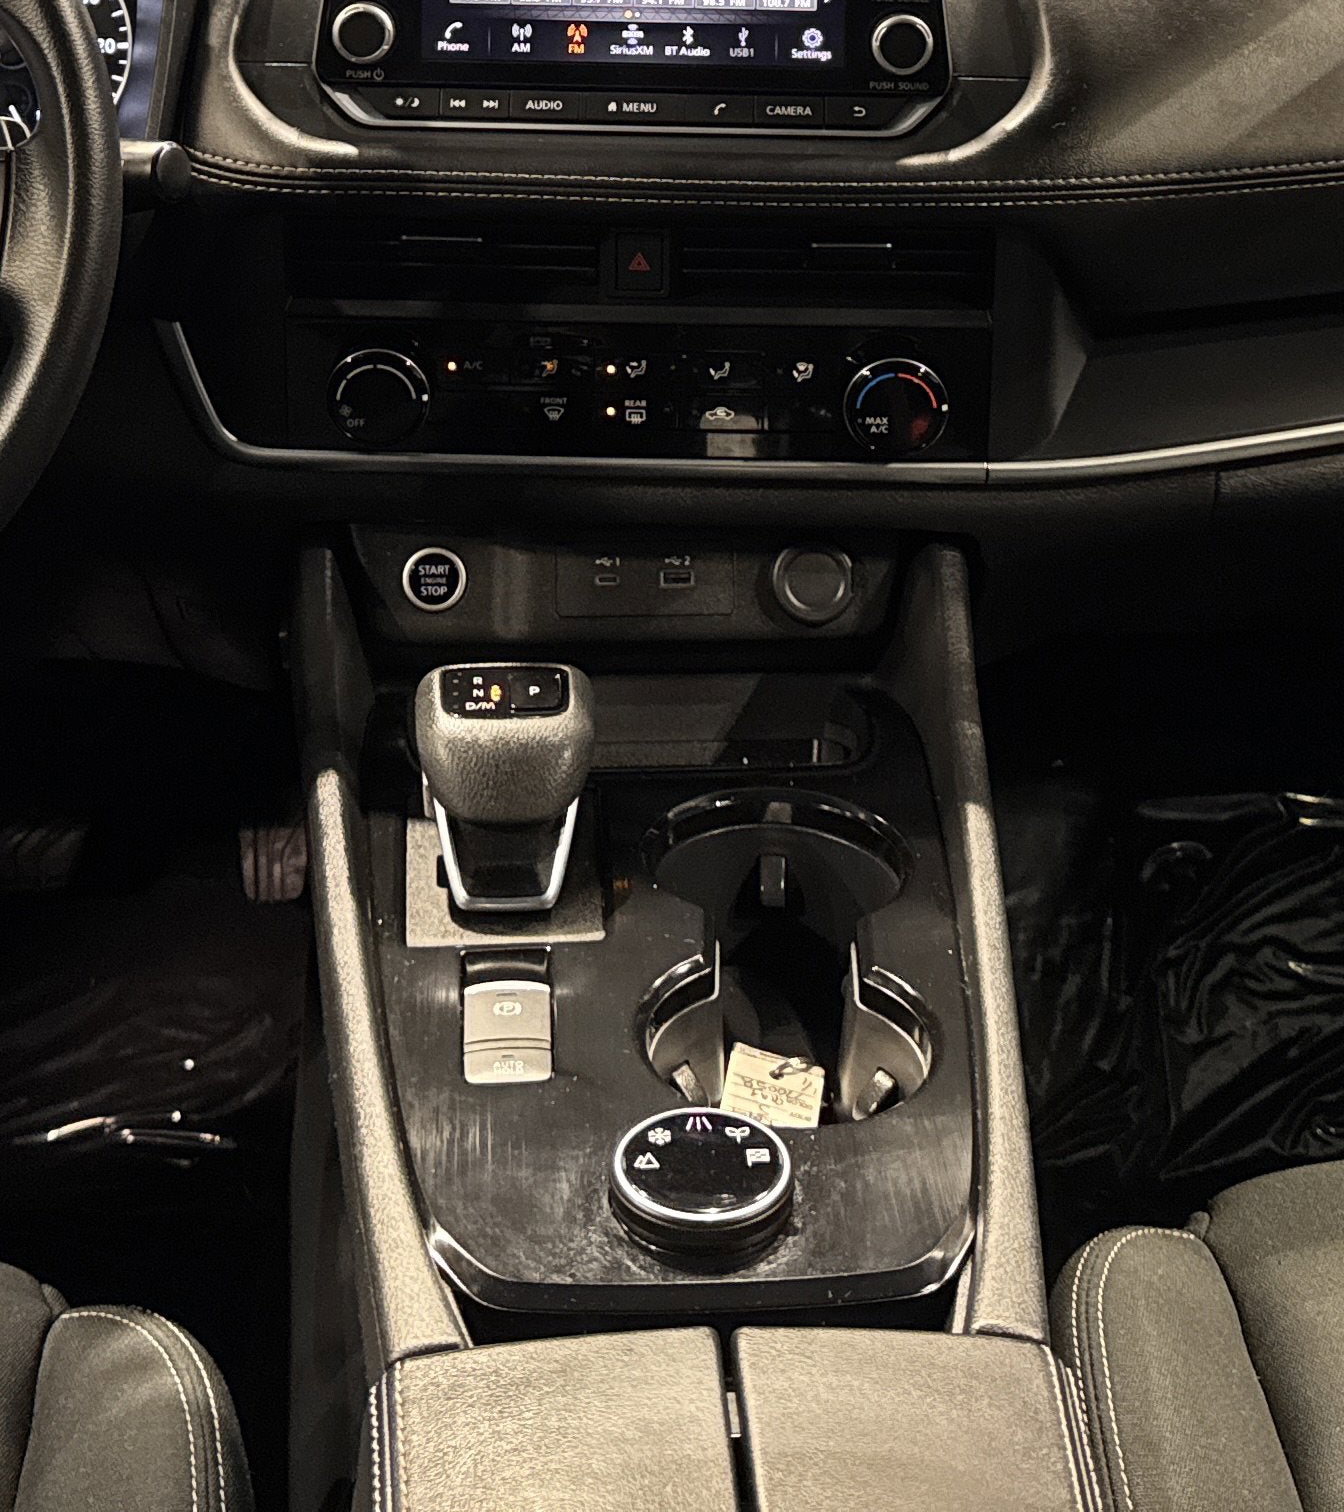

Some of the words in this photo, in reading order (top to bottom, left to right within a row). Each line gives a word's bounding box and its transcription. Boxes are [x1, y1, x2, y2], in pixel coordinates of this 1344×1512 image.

[437, 40, 470, 53] Phone
[511, 42, 531, 54] AM
[568, 43, 585, 55] FM
[609, 44, 654, 56] SiriusXM
[664, 45, 678, 57] BT
[679, 45, 711, 57] Audio
[729, 47, 755, 58] USB1
[791, 48, 833, 62] Settings
[346, 69, 372, 79] PUSH
[869, 81, 895, 90] PUSH
[898, 81, 930, 91] SOUND
[525, 99, 563, 112] AUDIO
[622, 101, 657, 114] MENU
[766, 104, 813, 117] CAMERA
[463, 360, 483, 370] A/C
[540, 397, 568, 405] FRONT
[624, 399, 647, 407] REAR
[346, 418, 366, 428] OFF
[865, 416, 888, 425] MAX
[870, 424, 889, 434] A/C
[418, 564, 450, 576] START
[420, 586, 448, 596] STOP
[472, 676, 483, 685] R
[472, 688, 484, 697] N
[528, 685, 541, 696] P
[465, 701, 496, 711] D/M
[493, 1060, 524, 1068] AUTO
